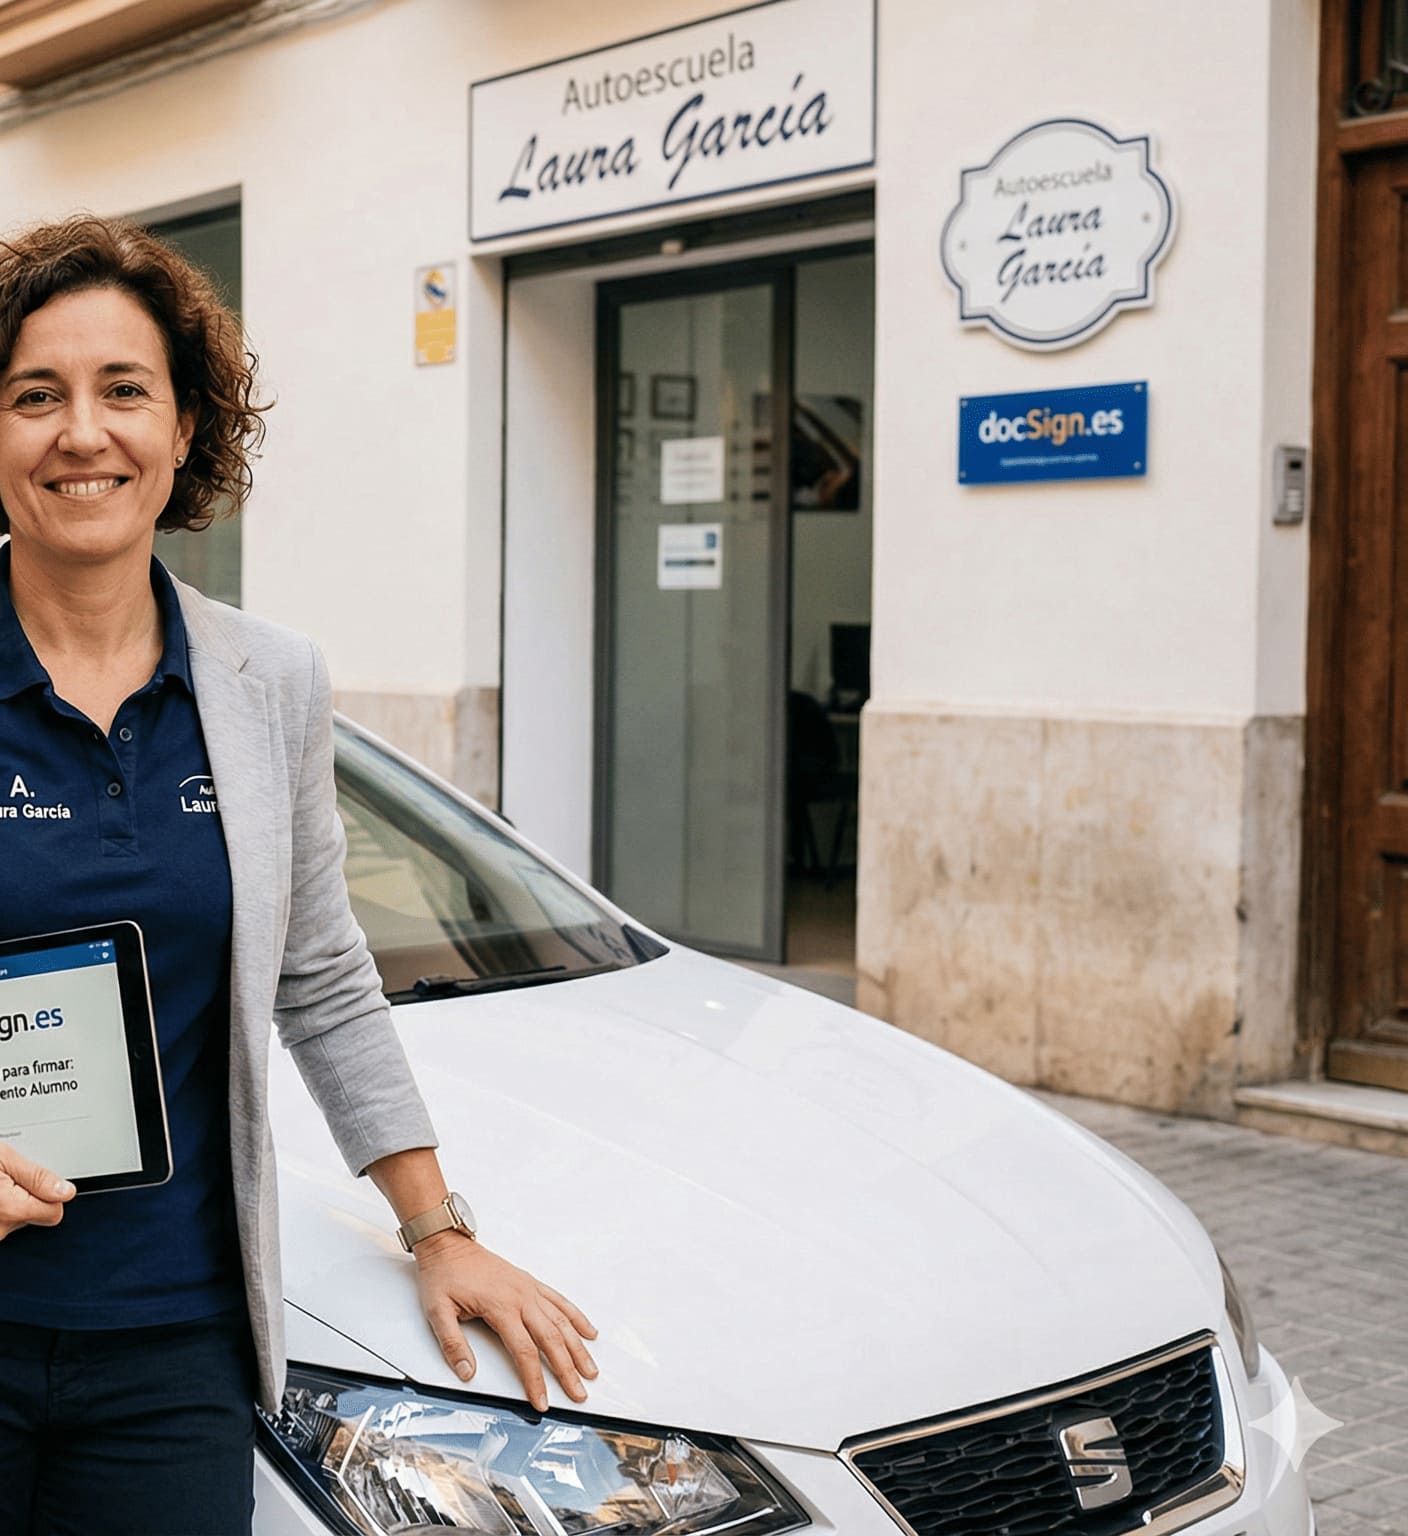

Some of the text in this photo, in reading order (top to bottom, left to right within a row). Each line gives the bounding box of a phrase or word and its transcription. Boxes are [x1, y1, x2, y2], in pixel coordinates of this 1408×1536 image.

[562, 33, 756, 115] Autoescuela
[499, 72, 834, 201] Laura García
[994, 161, 1113, 197] Autoescuela
[997, 201, 1105, 243] Laura
[997, 243, 1107, 304] García
[978, 409, 1125, 446] docSign.es
[10, 774, 35, 798] A.
[199, 784, 217, 795] Au
[22, 803, 71, 819] García
[180, 795, 217, 813] Laur
[2, 1065, 30, 1085] para
[33, 1058, 75, 1077] firmar:
[30, 1079, 79, 1097] Alumno
